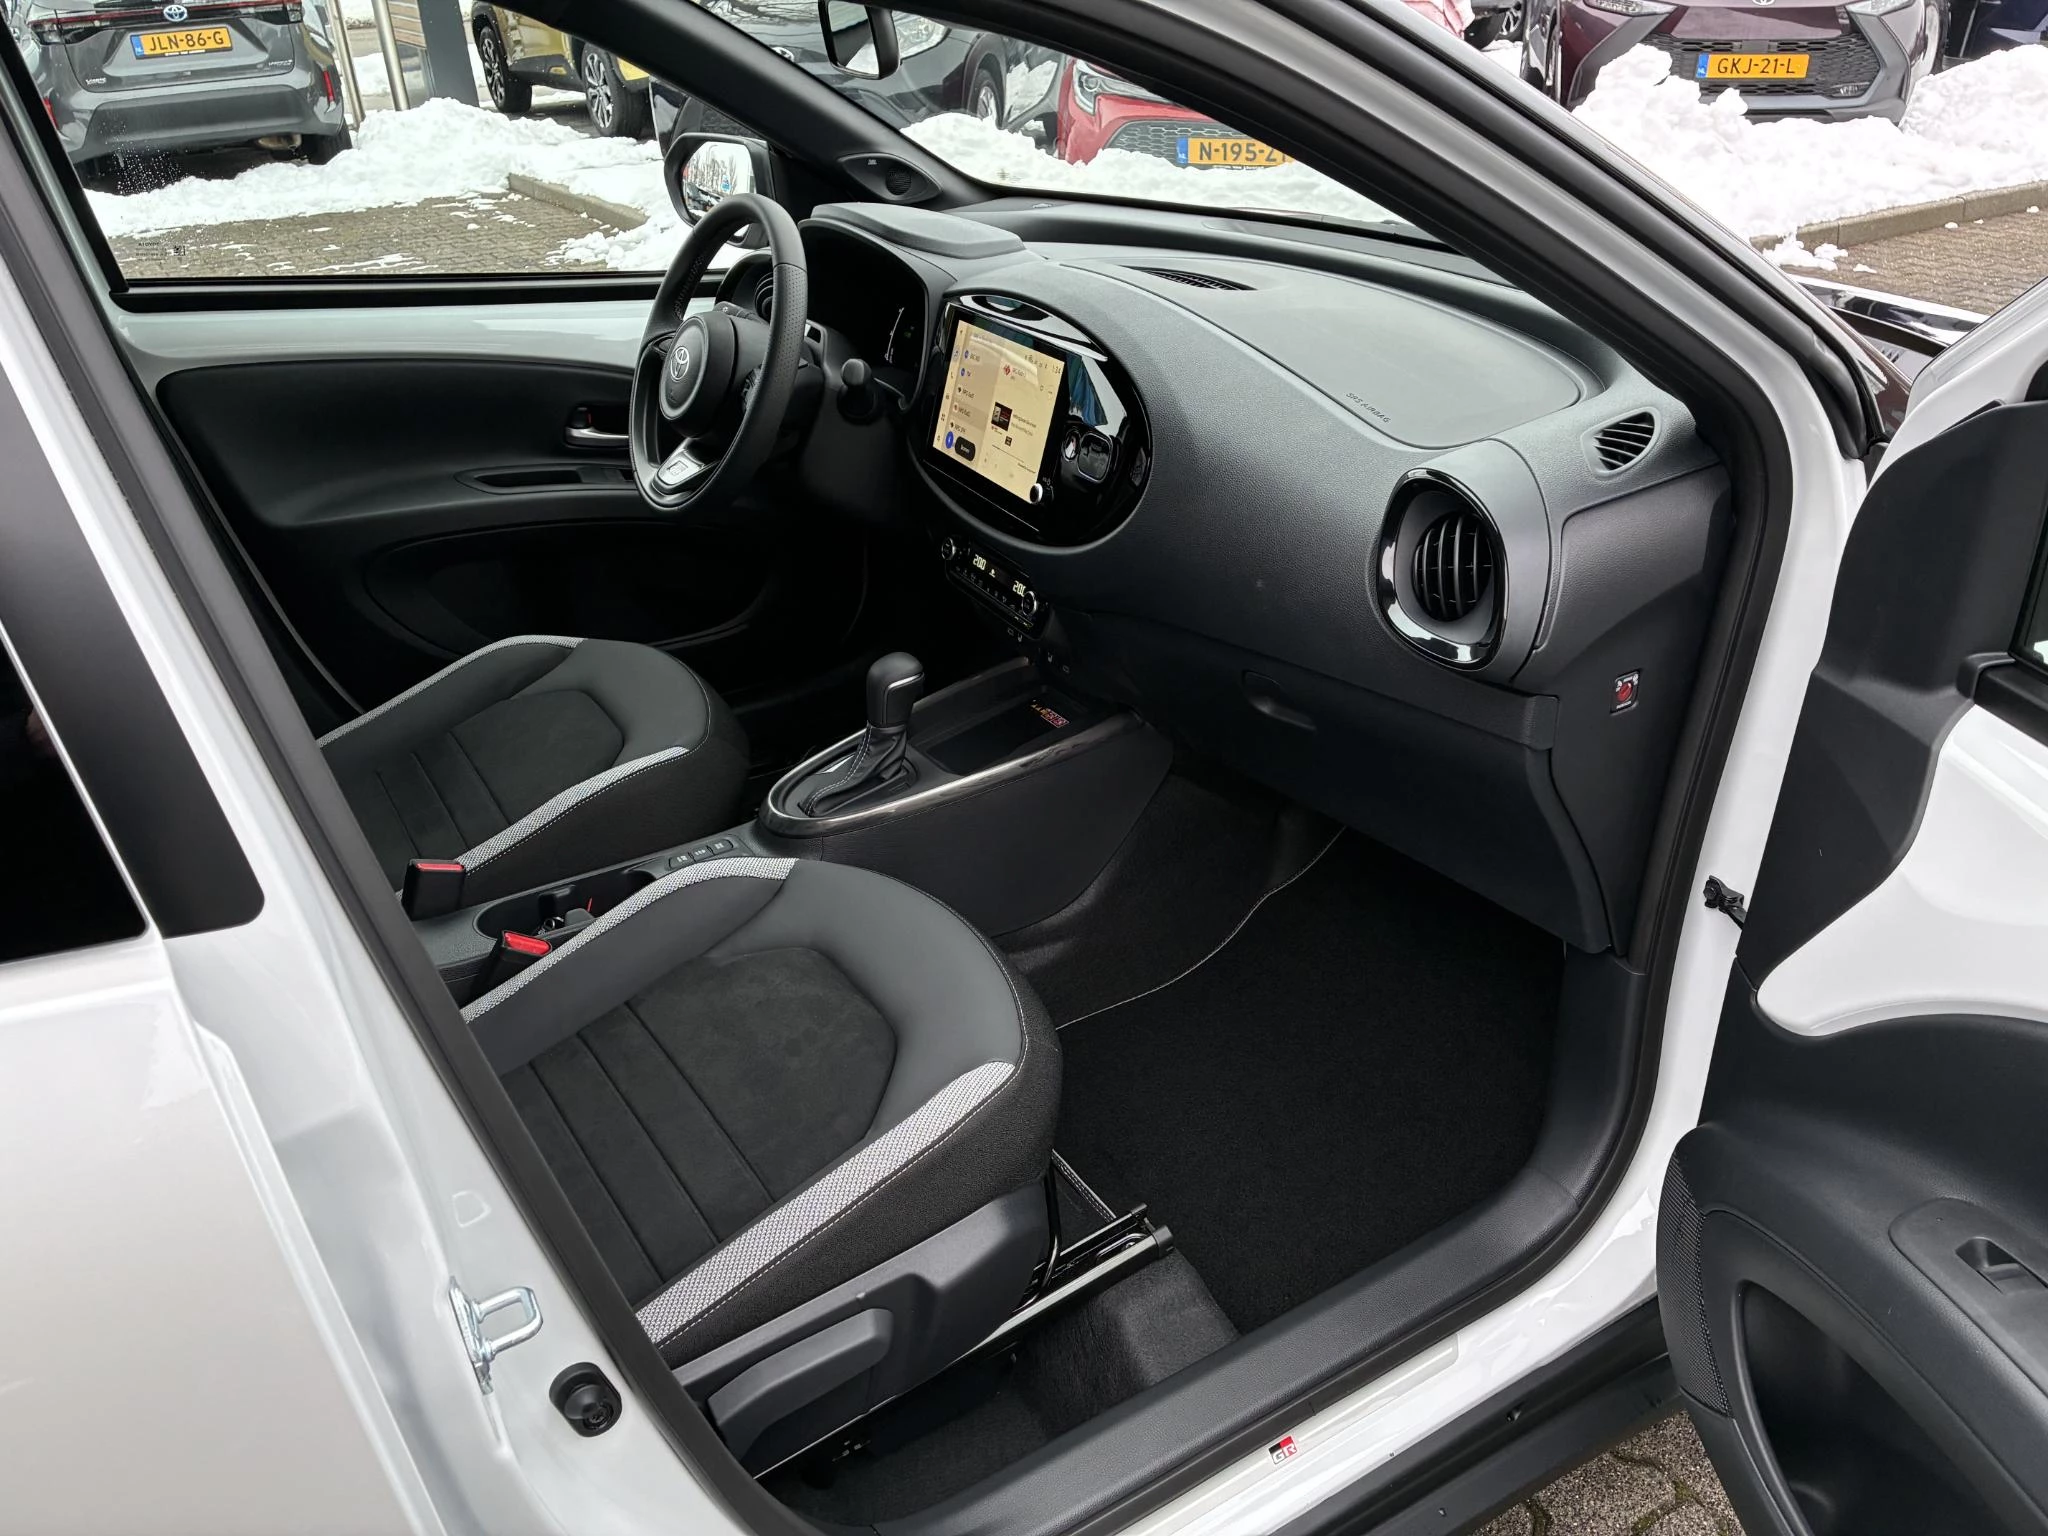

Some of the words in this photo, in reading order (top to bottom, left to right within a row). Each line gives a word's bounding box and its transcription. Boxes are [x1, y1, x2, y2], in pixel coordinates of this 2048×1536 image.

[150, 30, 225, 51] JLN-86-G
[1717, 58, 1796, 74] GKJ-21-L
[1345, 392, 1363, 403] SRS
[1360, 403, 1391, 423] AIRBAG
